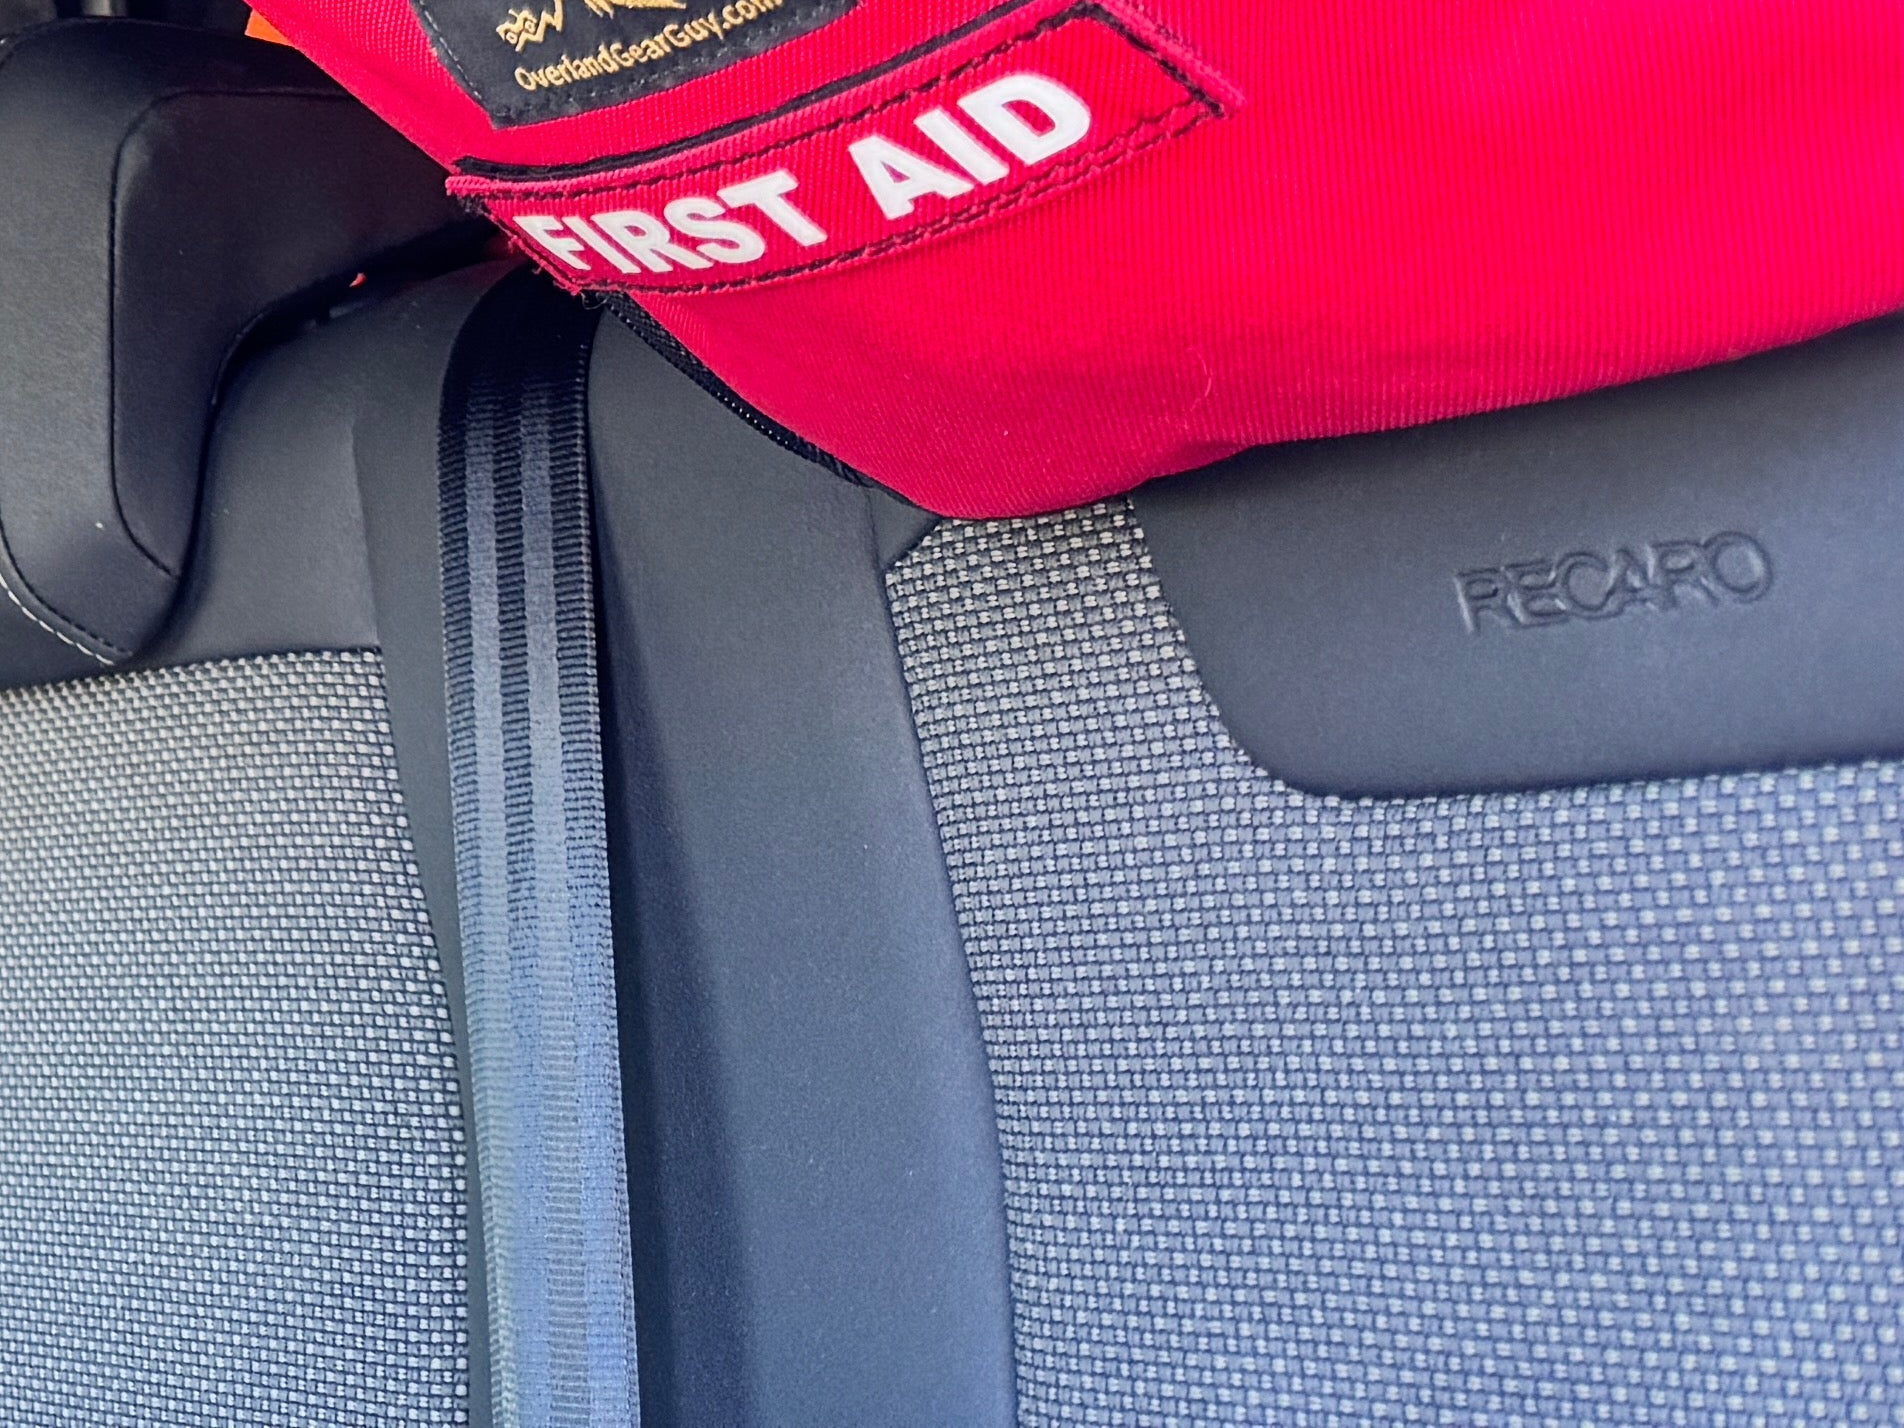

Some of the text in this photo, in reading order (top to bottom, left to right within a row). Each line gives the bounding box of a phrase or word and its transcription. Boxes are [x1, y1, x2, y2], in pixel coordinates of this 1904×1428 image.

[513, 72, 1092, 275] FIRST AID
[1452, 529, 1776, 636] RECARO
